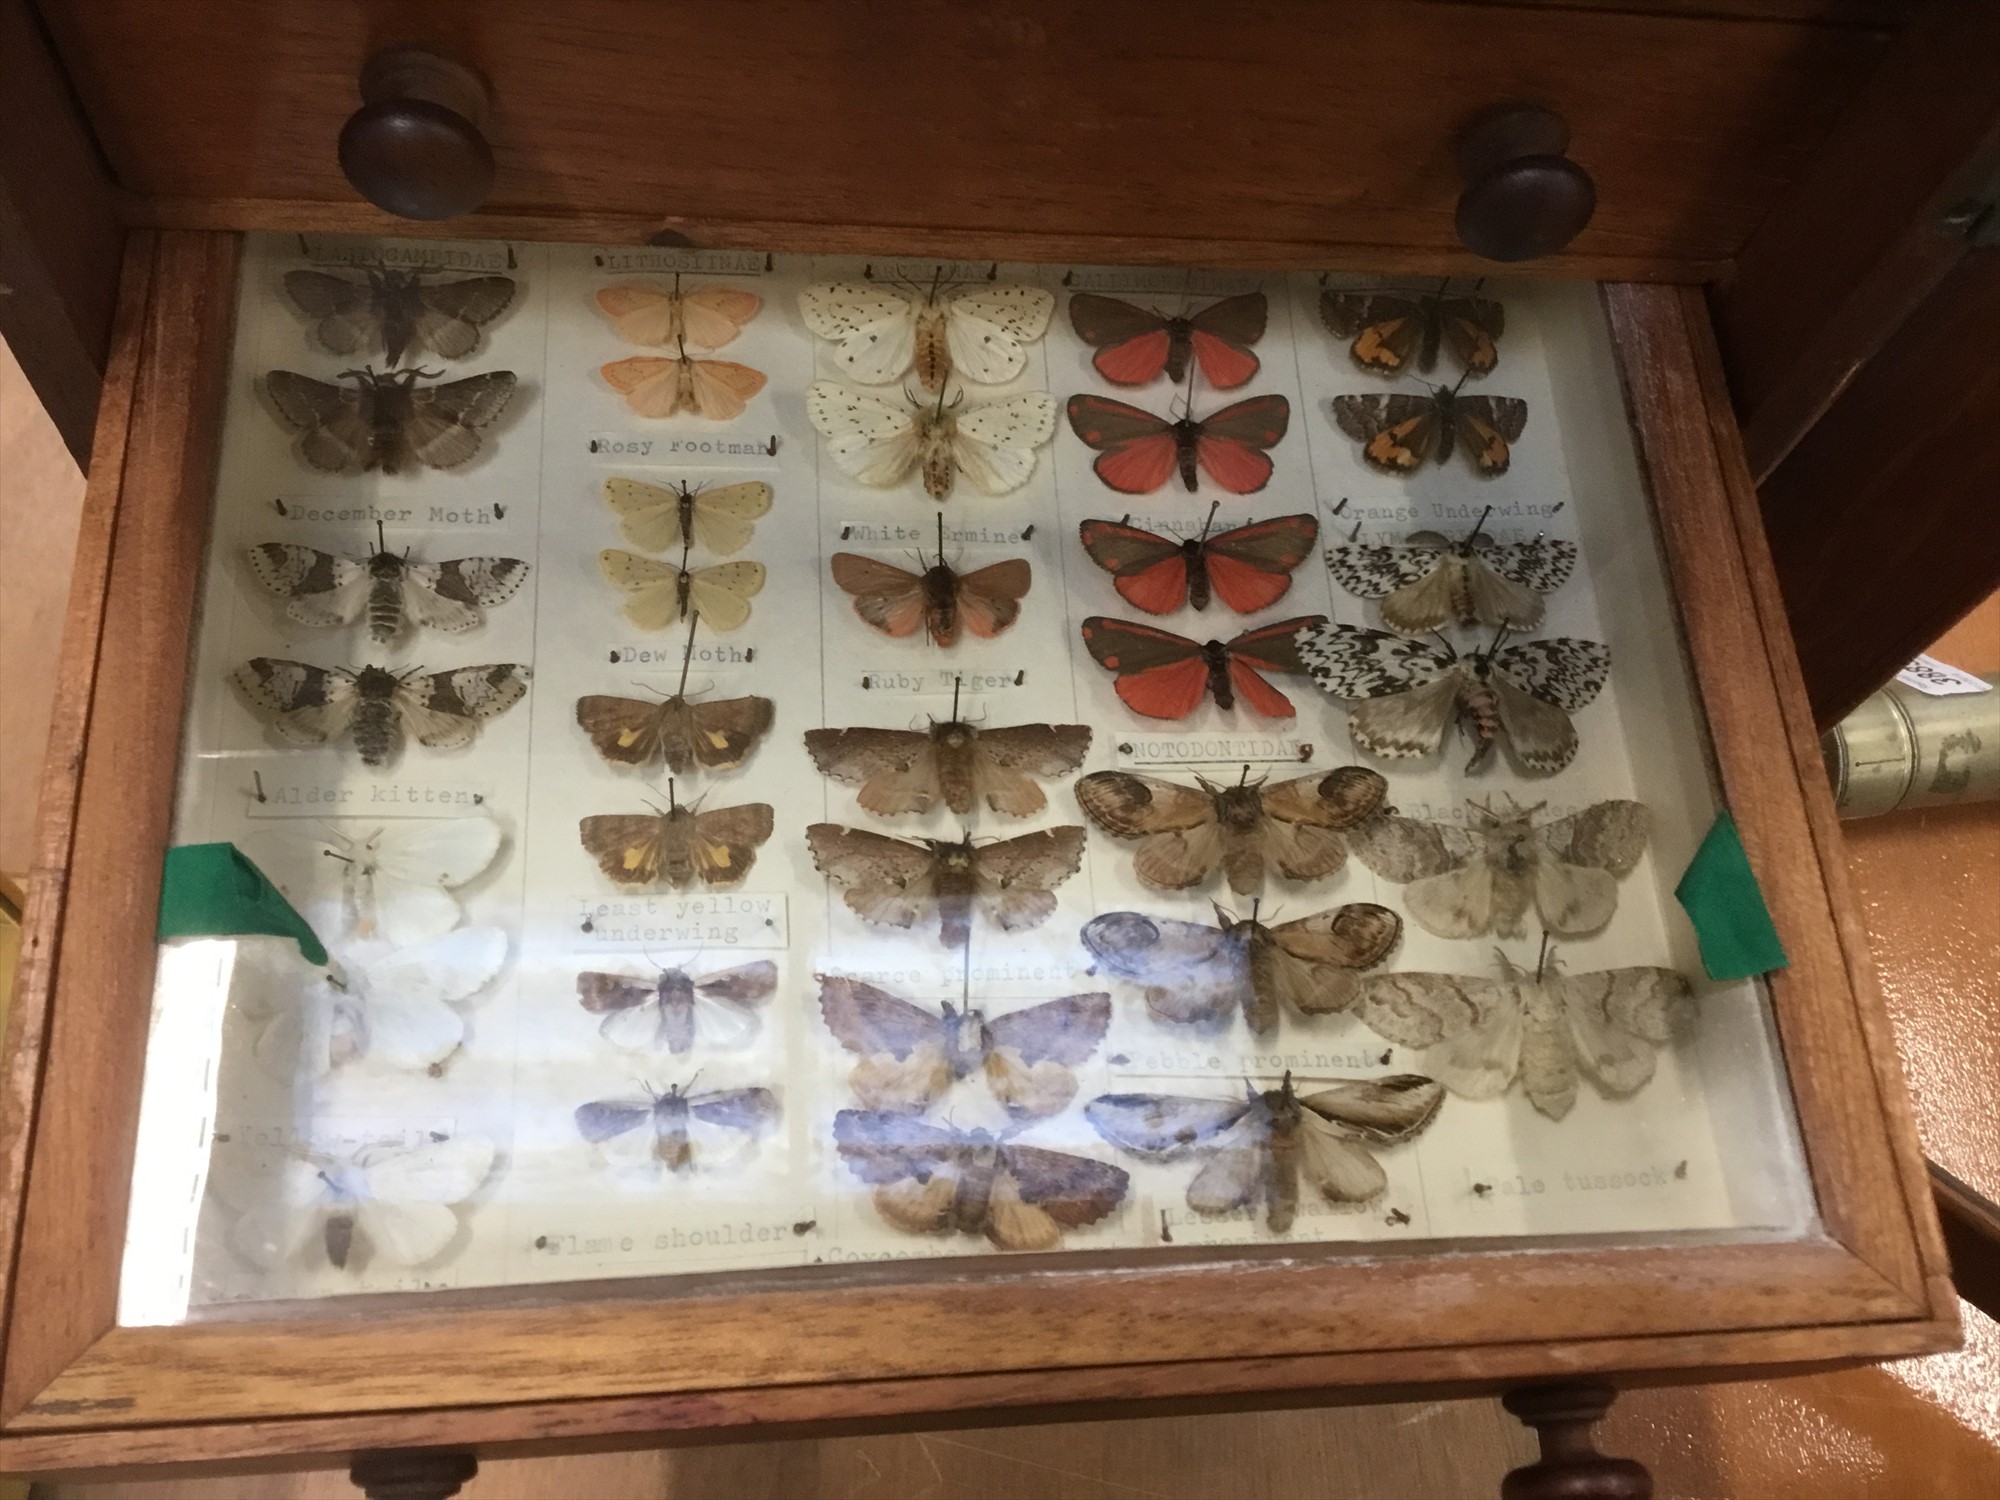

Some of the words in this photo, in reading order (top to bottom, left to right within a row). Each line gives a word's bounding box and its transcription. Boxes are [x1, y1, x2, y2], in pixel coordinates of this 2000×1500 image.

[598, 439, 653, 456] Rosy
[290, 504, 412, 522] December
[428, 506, 490, 524] Moth
[1341, 506, 1418, 522] Orange
[851, 525, 921, 541] White
[622, 646, 668, 663] Dew
[683, 645, 744, 662] Moth
[869, 673, 925, 692] Ruby
[939, 671, 1012, 690] Tiger
[272, 786, 353, 804] Alder
[370, 785, 470, 804] kitten
[580, 897, 658, 917] Least
[676, 897, 771, 919] yellow
[596, 922, 739, 944] underwing
[1240, 1050, 1375, 1073] prominent
[1563, 1165, 1668, 1191] tussock
[654, 1222, 787, 1251] shoulder
